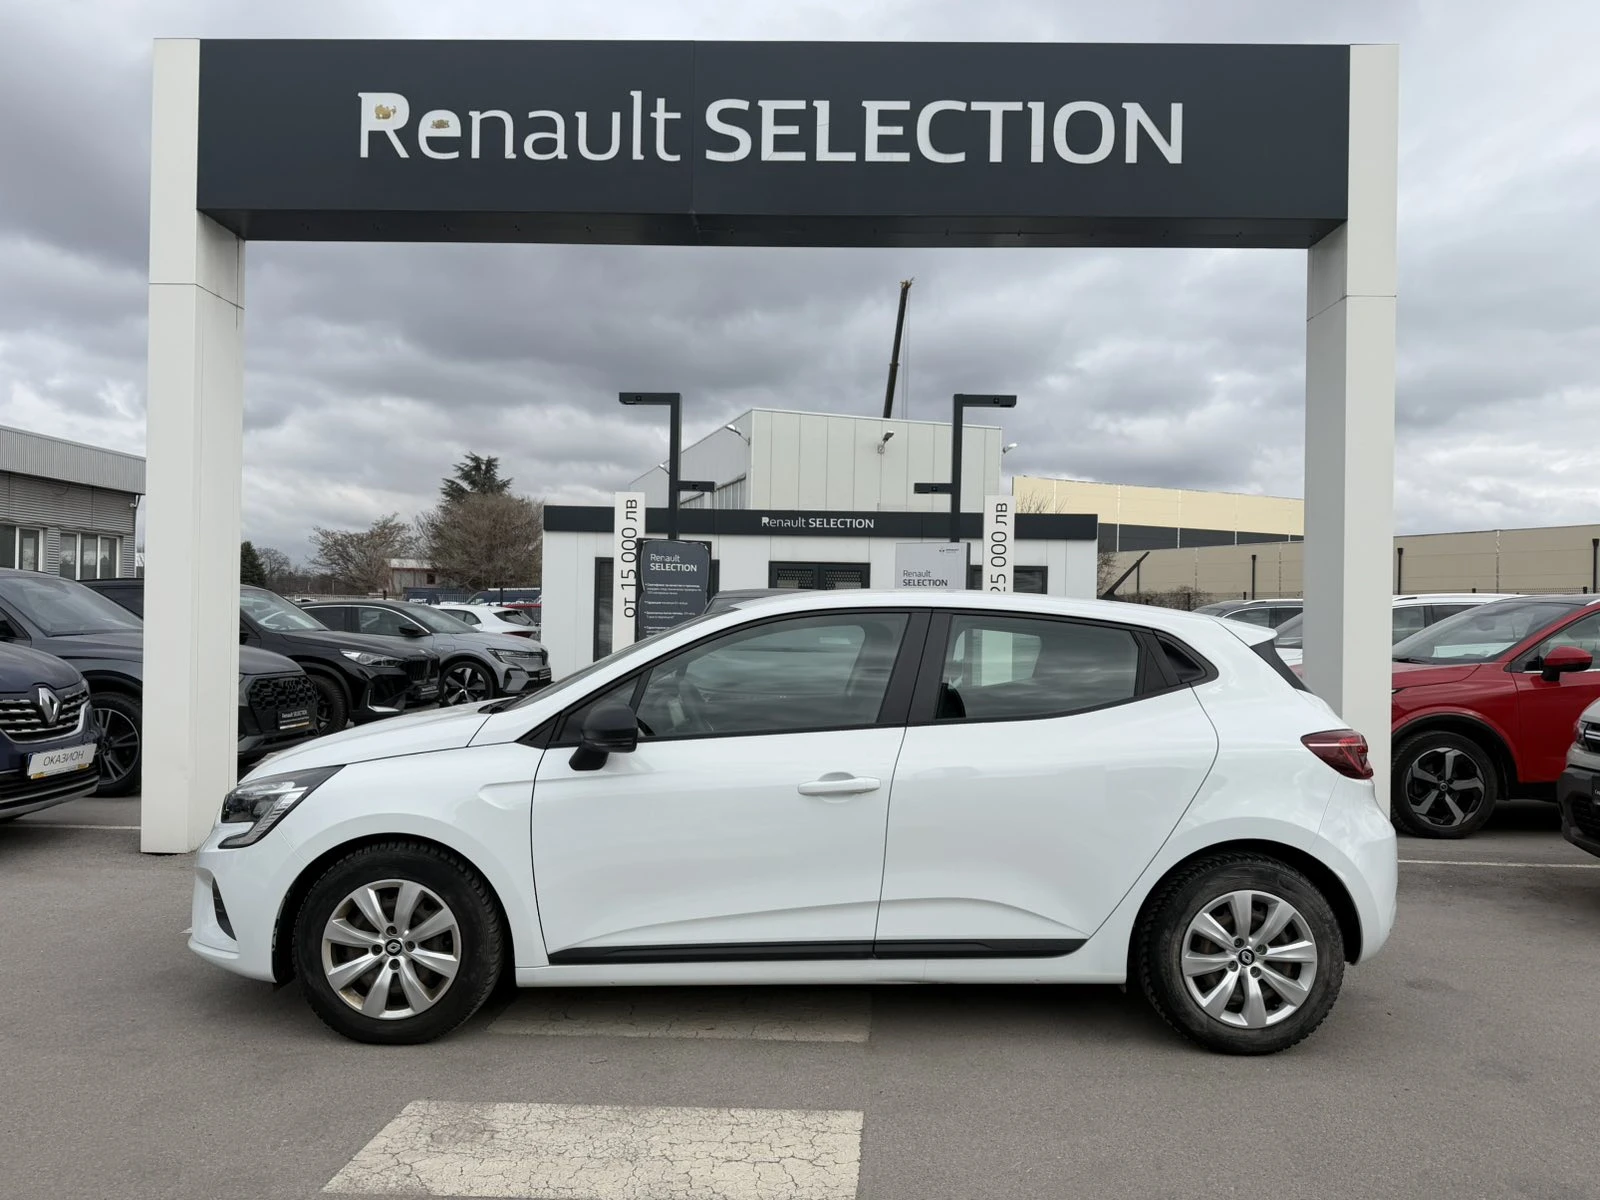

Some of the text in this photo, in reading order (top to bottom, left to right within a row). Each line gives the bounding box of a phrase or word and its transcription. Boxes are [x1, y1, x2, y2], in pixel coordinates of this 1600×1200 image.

[358, 90, 1183, 165] Renault SELECTION
[761, 516, 875, 529] Renault SELECTION
[621, 527, 637, 563] 000
[990, 531, 1007, 567] 000
[650, 553, 680, 562] Renault
[650, 562, 697, 572] SELECTION
[902, 569, 931, 578] Renault
[621, 569, 636, 590] 15
[902, 578, 948, 587] SELECTION
[43, 750, 84, 767] ОКАЗИОН
